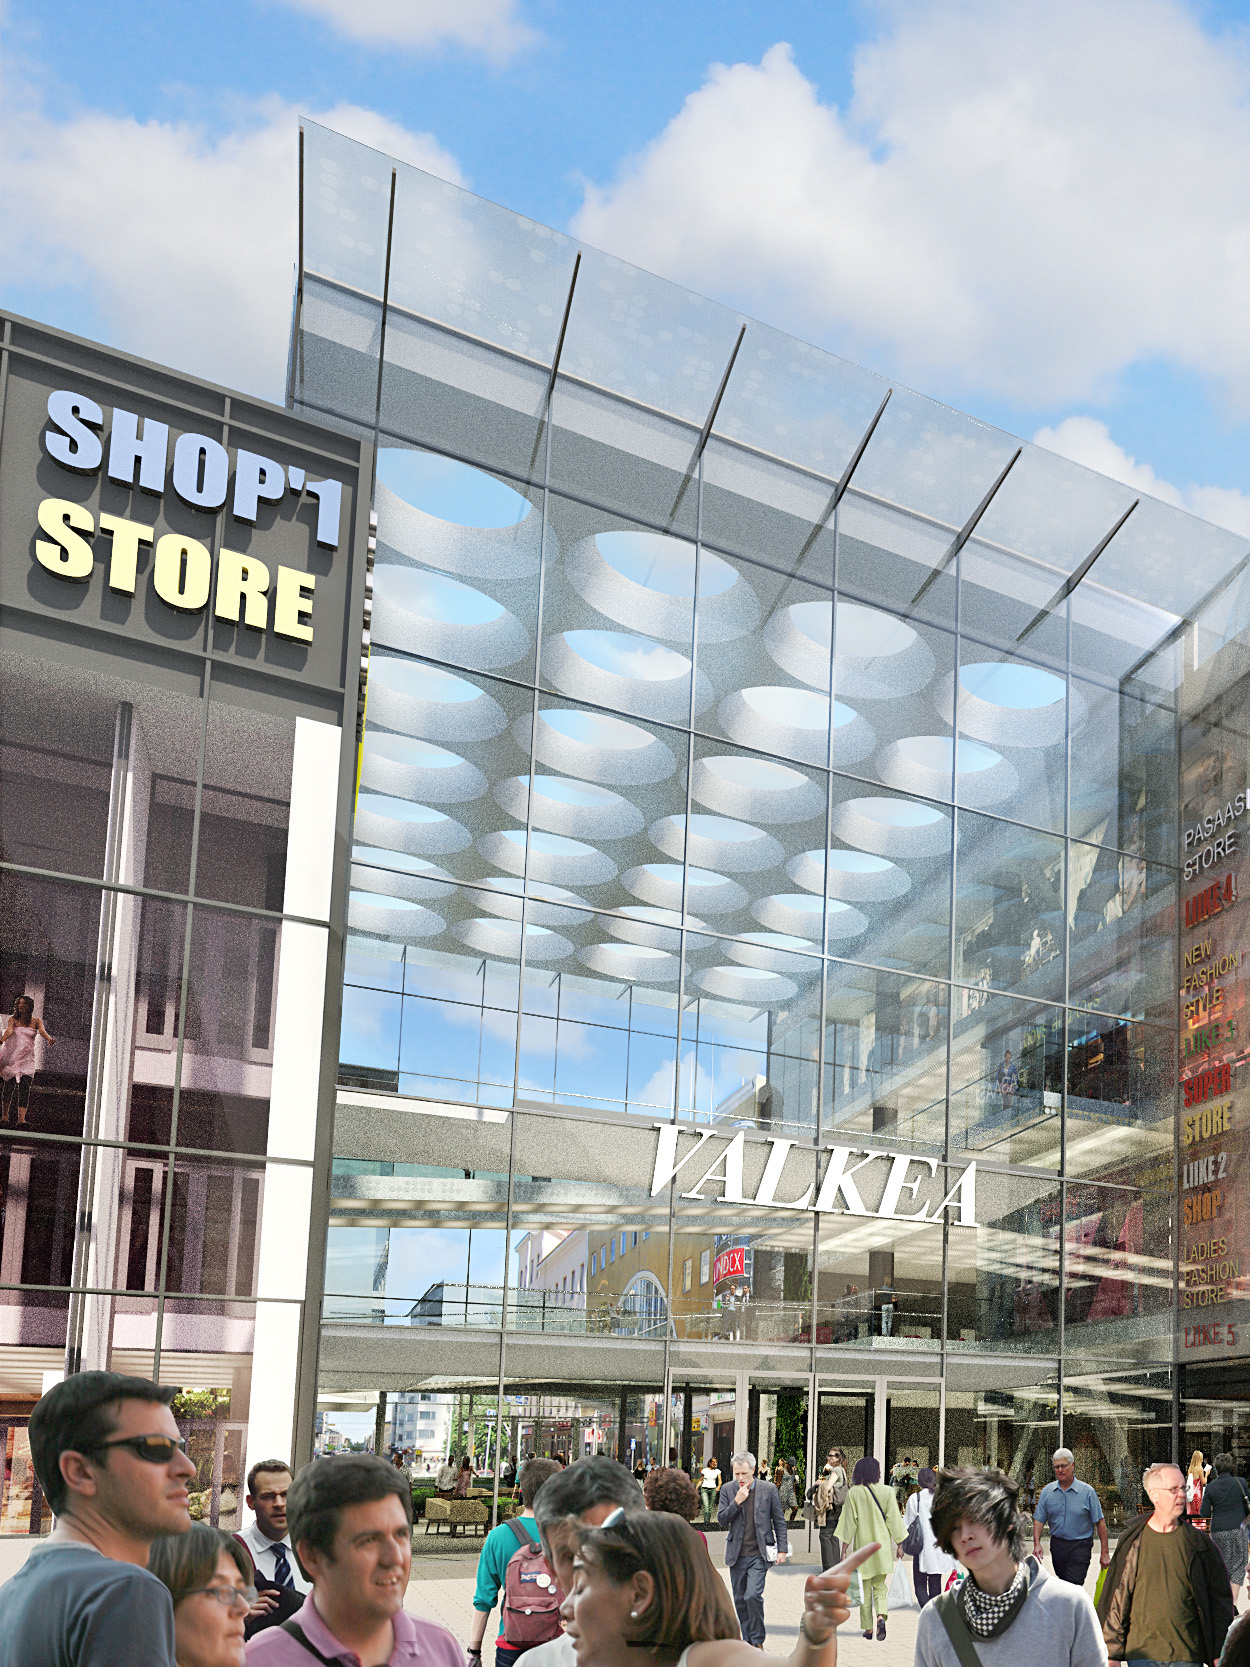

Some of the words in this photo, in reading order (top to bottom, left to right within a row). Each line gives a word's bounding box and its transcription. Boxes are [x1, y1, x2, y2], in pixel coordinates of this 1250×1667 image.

[35, 498, 316, 644] STORE
[1184, 831, 1236, 881] STORE
[1185, 879, 1222, 928] LIIKE
[1222, 873, 1237, 904] 4
[1184, 937, 1212, 968] NEW
[1184, 950, 1238, 990] FASHION
[1184, 987, 1222, 1020] STYLE
[1184, 1023, 1221, 1058] LIIKE
[1225, 1019, 1235, 1041] 3
[1184, 1063, 1231, 1108] SUPER
[1183, 1101, 1231, 1145] STORE
[650, 1123, 980, 1228] VALKEA
[1183, 1156, 1218, 1190] LIIKE
[1218, 1152, 1227, 1179] 2
[1184, 1190, 1221, 1225] SHOP
[1184, 1237, 1227, 1264] LADIES
[1184, 1259, 1239, 1287] FASHION
[1183, 1284, 1226, 1309] STORE
[1184, 1322, 1222, 1348] LIIKE
[1227, 1323, 1235, 1347] 5
